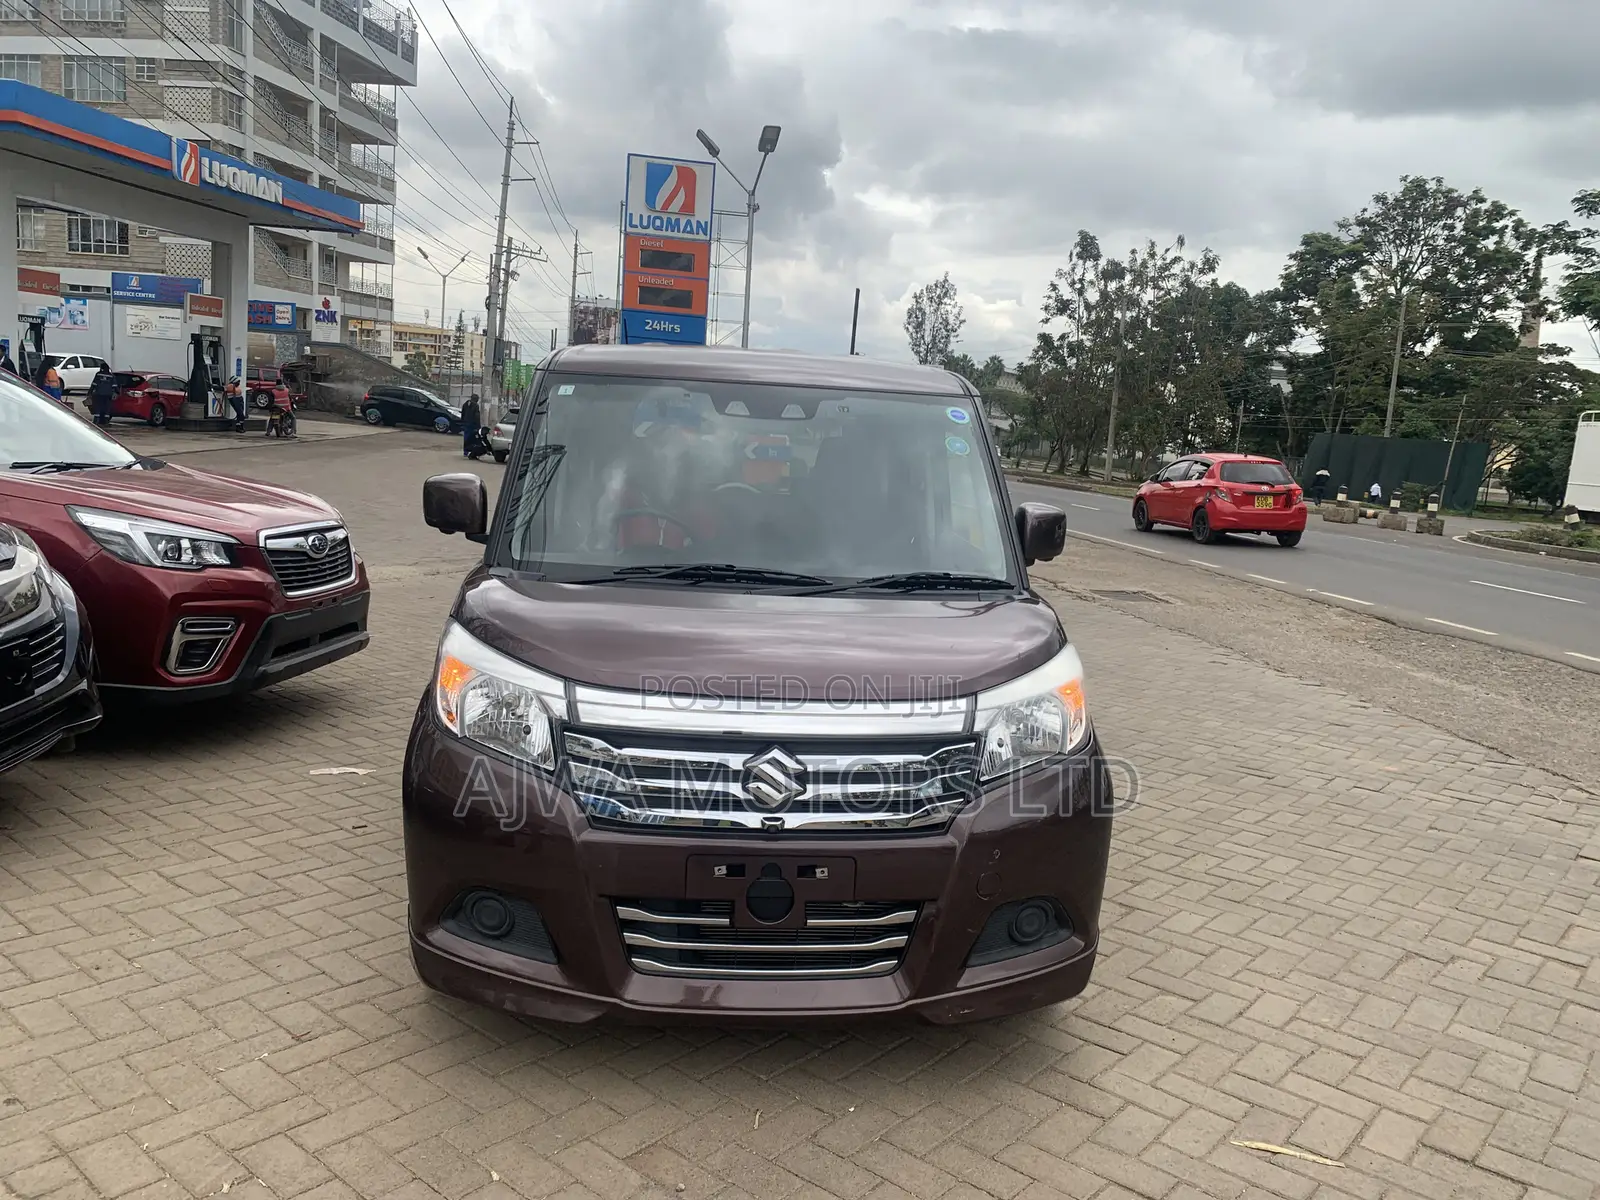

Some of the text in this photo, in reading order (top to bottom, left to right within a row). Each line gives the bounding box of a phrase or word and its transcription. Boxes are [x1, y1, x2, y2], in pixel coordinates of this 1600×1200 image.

[201, 157, 283, 204] LUQMAN
[628, 212, 709, 236] LUQMAN
[639, 239, 664, 248] Diesel
[638, 275, 674, 286] Unleaded
[315, 309, 338, 323] ZNK
[644, 319, 681, 333] 24Hrs
